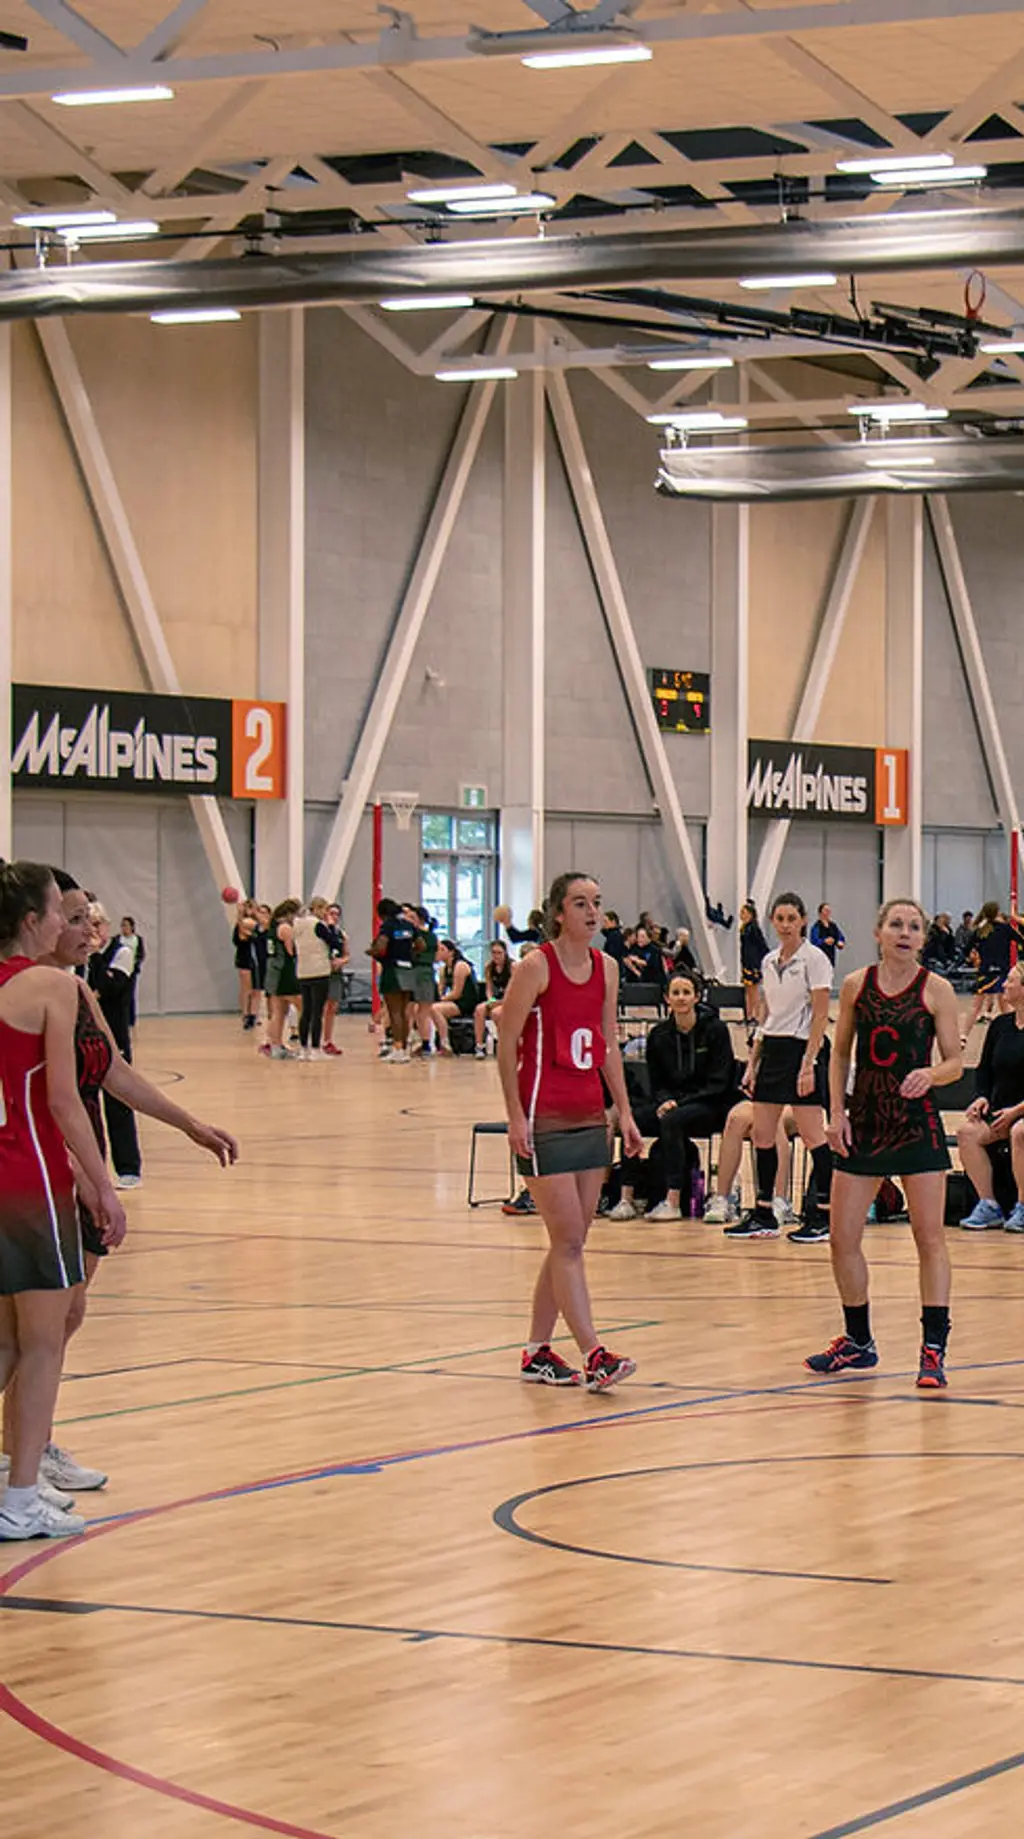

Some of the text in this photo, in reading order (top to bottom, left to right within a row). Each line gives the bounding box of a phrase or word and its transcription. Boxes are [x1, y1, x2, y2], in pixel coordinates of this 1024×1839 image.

[245, 708, 274, 792] 2
[883, 754, 901, 820] 1
[570, 1027, 594, 1070] C
[869, 1024, 900, 1068] C
